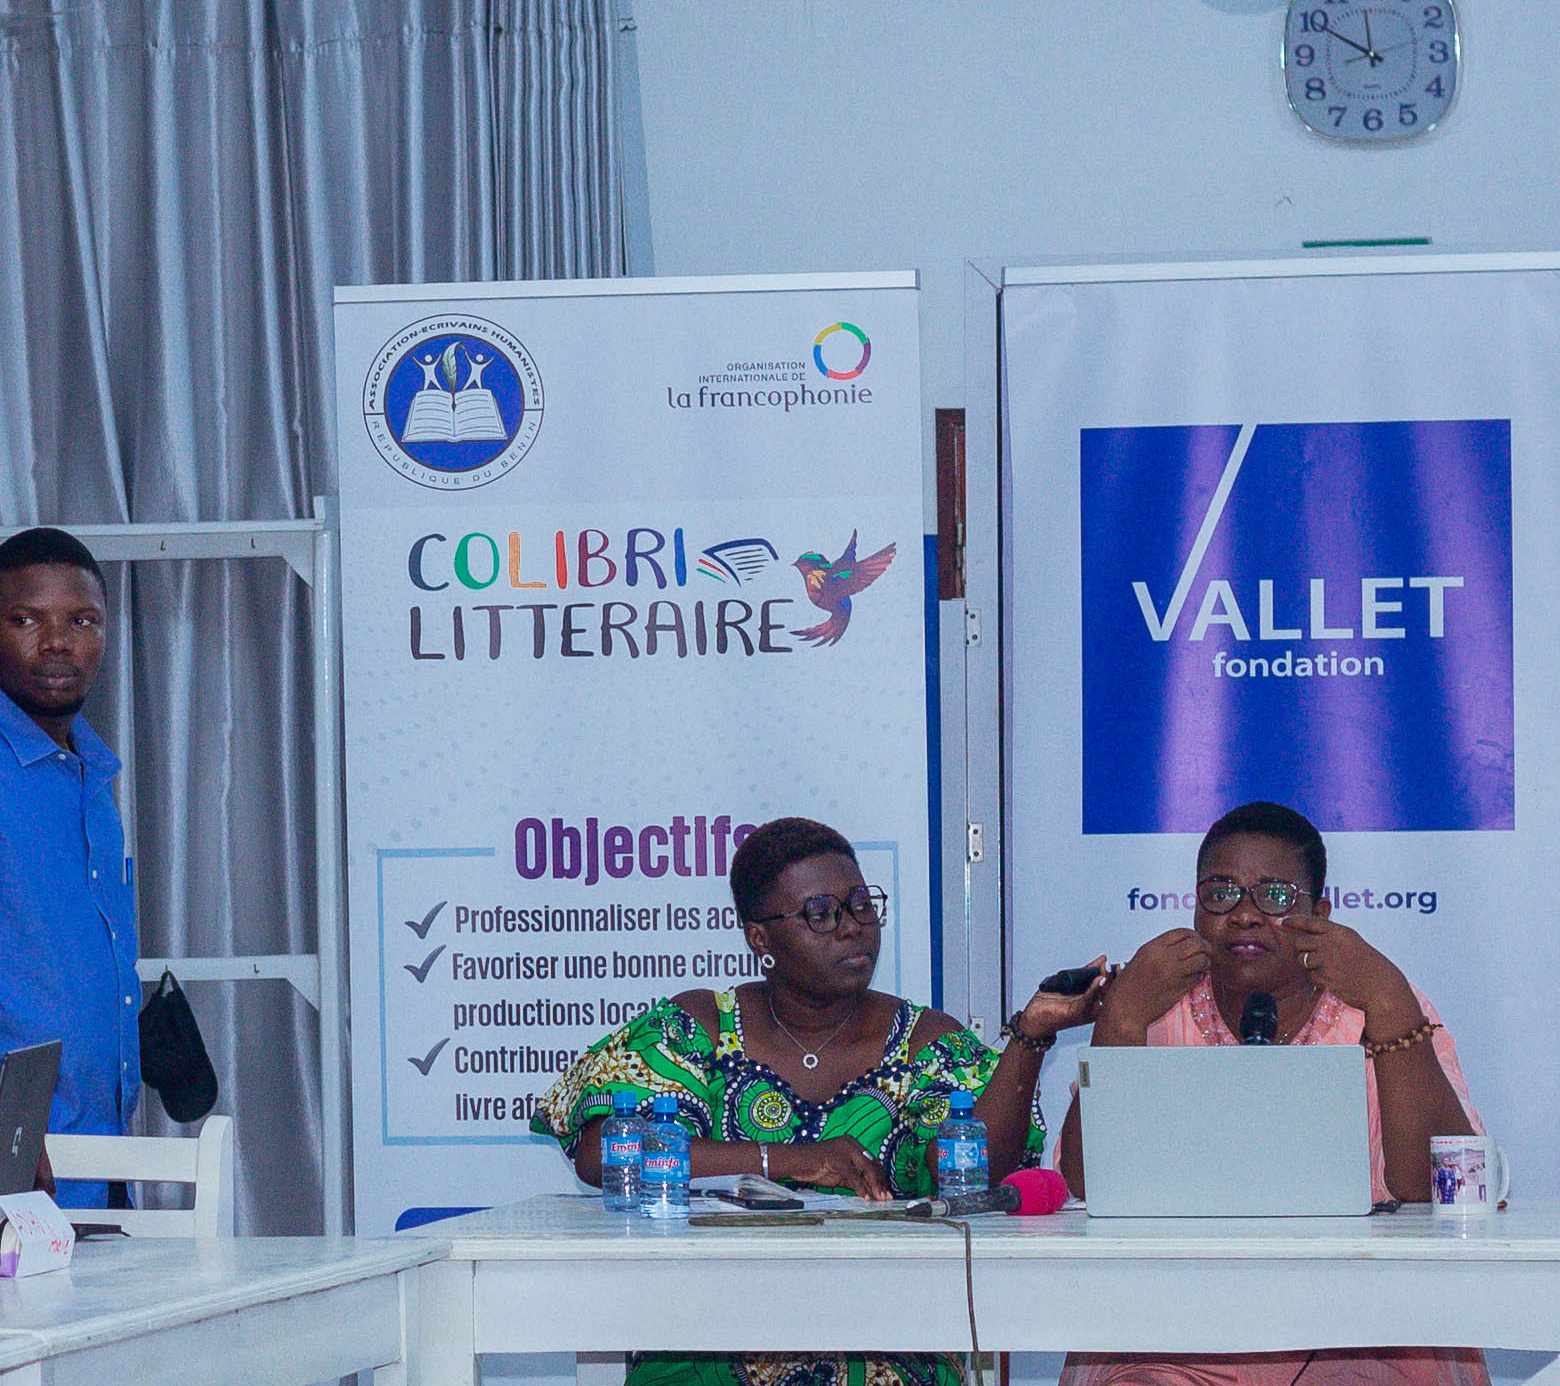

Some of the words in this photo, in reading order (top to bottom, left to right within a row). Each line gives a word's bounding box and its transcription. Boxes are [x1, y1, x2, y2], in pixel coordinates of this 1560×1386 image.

[1300, 9, 1329, 33] 10
[1423, 6, 1444, 28] 2
[1294, 44, 1315, 67] 9
[1429, 40, 1449, 63] 3
[1305, 77, 1326, 101] 8
[1424, 76, 1445, 98] 4
[1329, 107, 1348, 127] 7
[1363, 108, 1384, 131] 6
[1398, 103, 1418, 126] 5
[491, 330, 540, 405] HUMANISTES
[698, 373, 788, 383] INTERNATIONALE
[791, 372, 806, 381] DE
[726, 361, 806, 372] ORGANISATION
[667, 387, 691, 409] la
[699, 384, 873, 412] francophonie
[372, 420, 461, 485] REPUBLIQUE
[473, 472, 492, 482] DU
[500, 422, 537, 468] BENIN
[408, 527, 687, 591] COLIBRI
[410, 599, 794, 660] LITTERAIRE
[1212, 651, 1385, 678] fondation
[455, 905, 660, 934] Professionnaliser
[666, 903, 700, 931] les
[452, 952, 559, 981] Favoriser
[564, 954, 607, 979] une
[613, 951, 686, 978] bonne
[453, 998, 595, 1030] productions
[454, 1045, 578, 1074] Contribuer
[455, 1093, 506, 1121] livre
